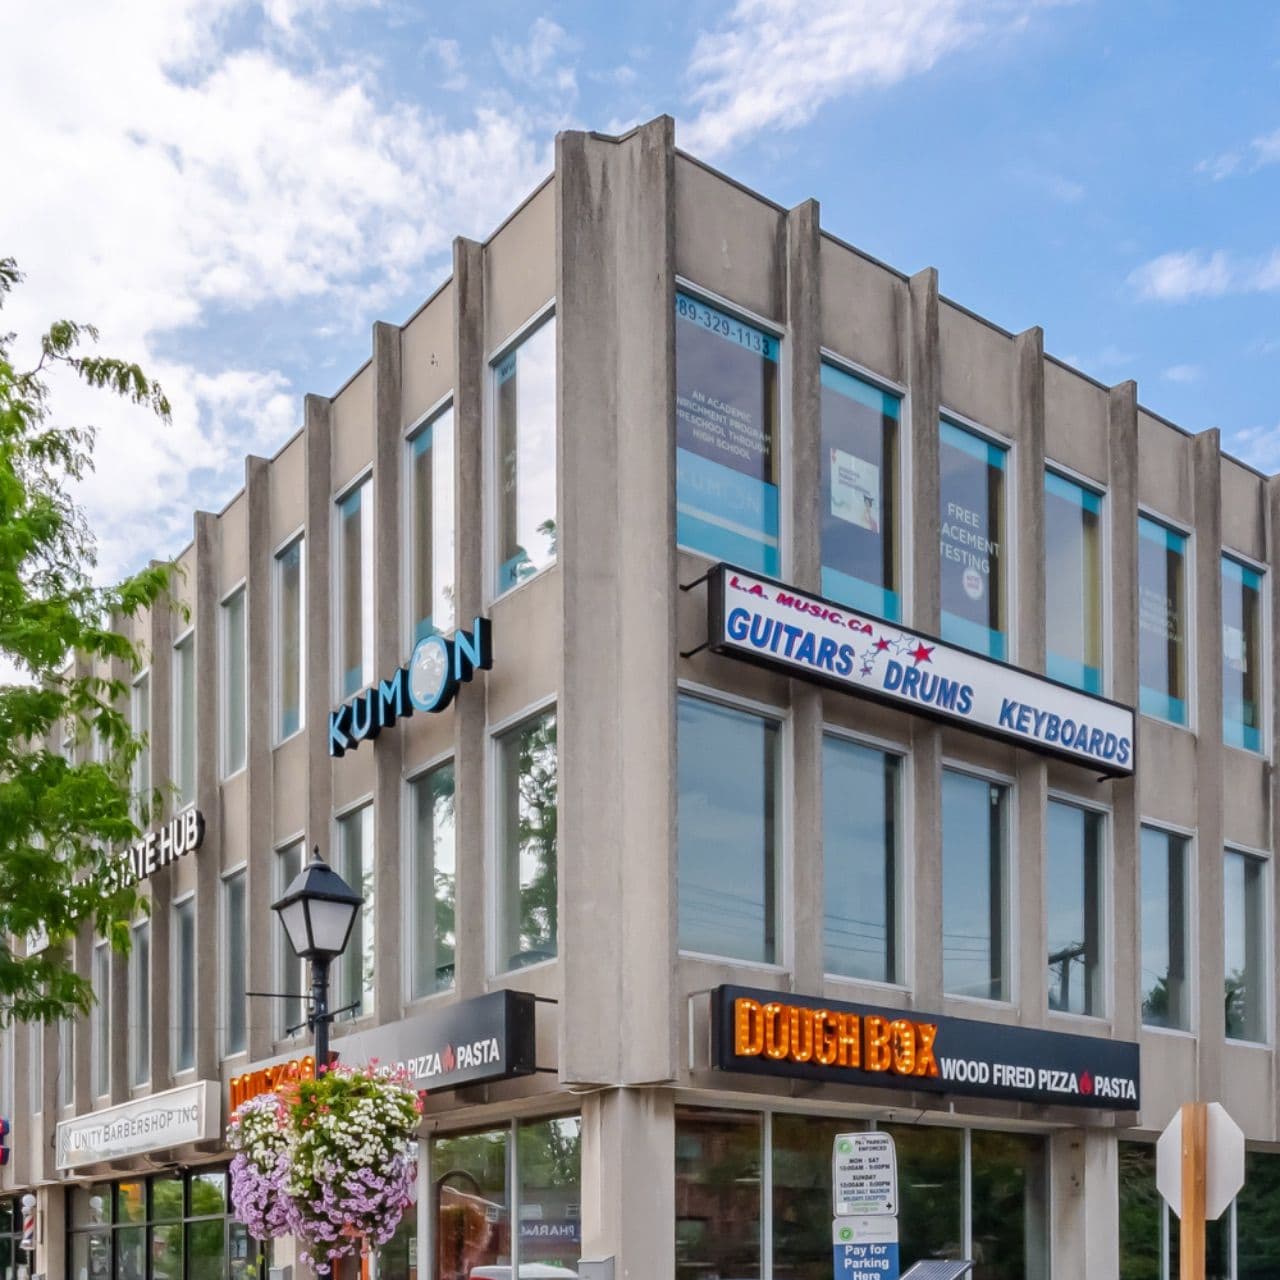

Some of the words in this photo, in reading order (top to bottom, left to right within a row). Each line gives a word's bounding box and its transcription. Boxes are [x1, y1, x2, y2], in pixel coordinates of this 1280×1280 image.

[676, 297, 770, 356] 89-329-1133
[947, 502, 980, 529] FREE
[940, 541, 990, 574] TESTING
[941, 521, 1000, 559] ACEMENT
[728, 575, 769, 600] L.A.
[775, 592, 874, 637] MUSIC.CA
[328, 616, 490, 758] KUMON
[726, 606, 857, 677] GUITARS
[883, 658, 975, 715] DRUMS
[998, 697, 1132, 765] KEYBOARDS
[160, 808, 200, 866] HUB
[407, 1052, 443, 1081] PIZZA
[457, 1037, 501, 1070] PASTA
[734, 997, 861, 1068] DOUGH
[863, 1014, 940, 1078] BOX
[940, 1057, 990, 1084] WOOD
[993, 1063, 1036, 1089] FIRED
[1038, 1069, 1079, 1094] PIZZA
[1094, 1076, 1137, 1100] PASTA
[177, 1104, 200, 1124] INC
[844, 1258, 889, 1270] Parking
[845, 1245, 868, 1258] Pay
[870, 1244, 887, 1255] for
[853, 1271, 881, 1280] Here
